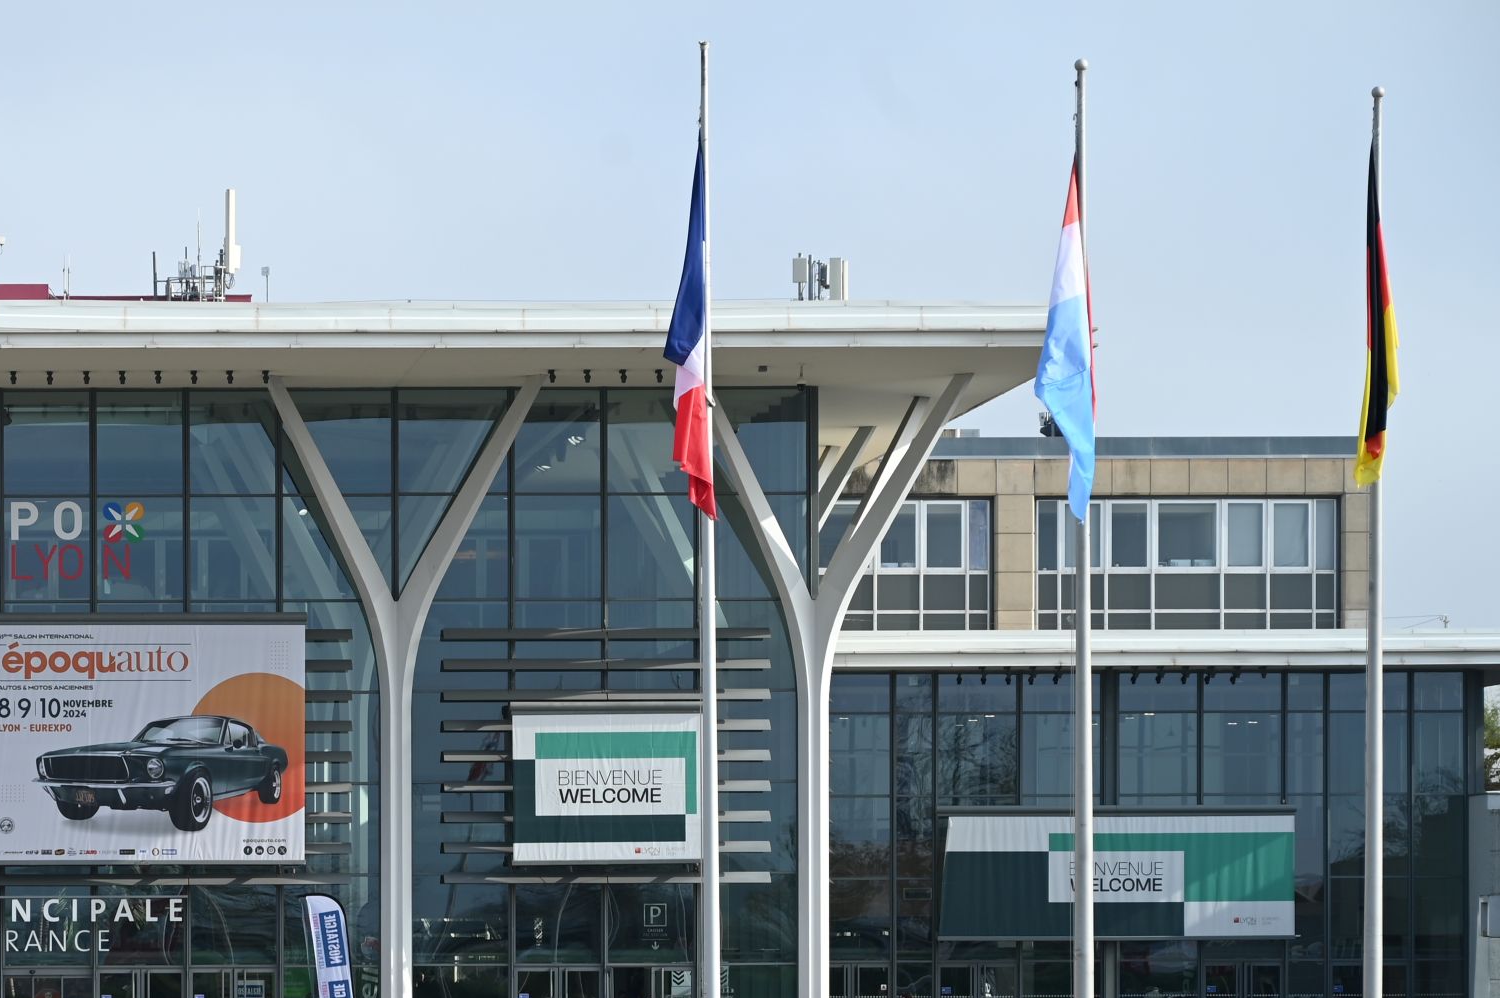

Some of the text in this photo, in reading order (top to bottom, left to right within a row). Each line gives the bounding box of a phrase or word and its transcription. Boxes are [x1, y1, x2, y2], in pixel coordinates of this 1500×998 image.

[10, 543, 132, 581] LYON
[17, 698, 32, 719] 9
[39, 698, 61, 719] 10
[63, 699, 113, 708] NOVEMBRE
[63, 709, 87, 718] 2024
[29, 724, 72, 732] EUREXPO
[557, 769, 663, 786] BIENVENUE
[558, 788, 662, 804] WELCOME
